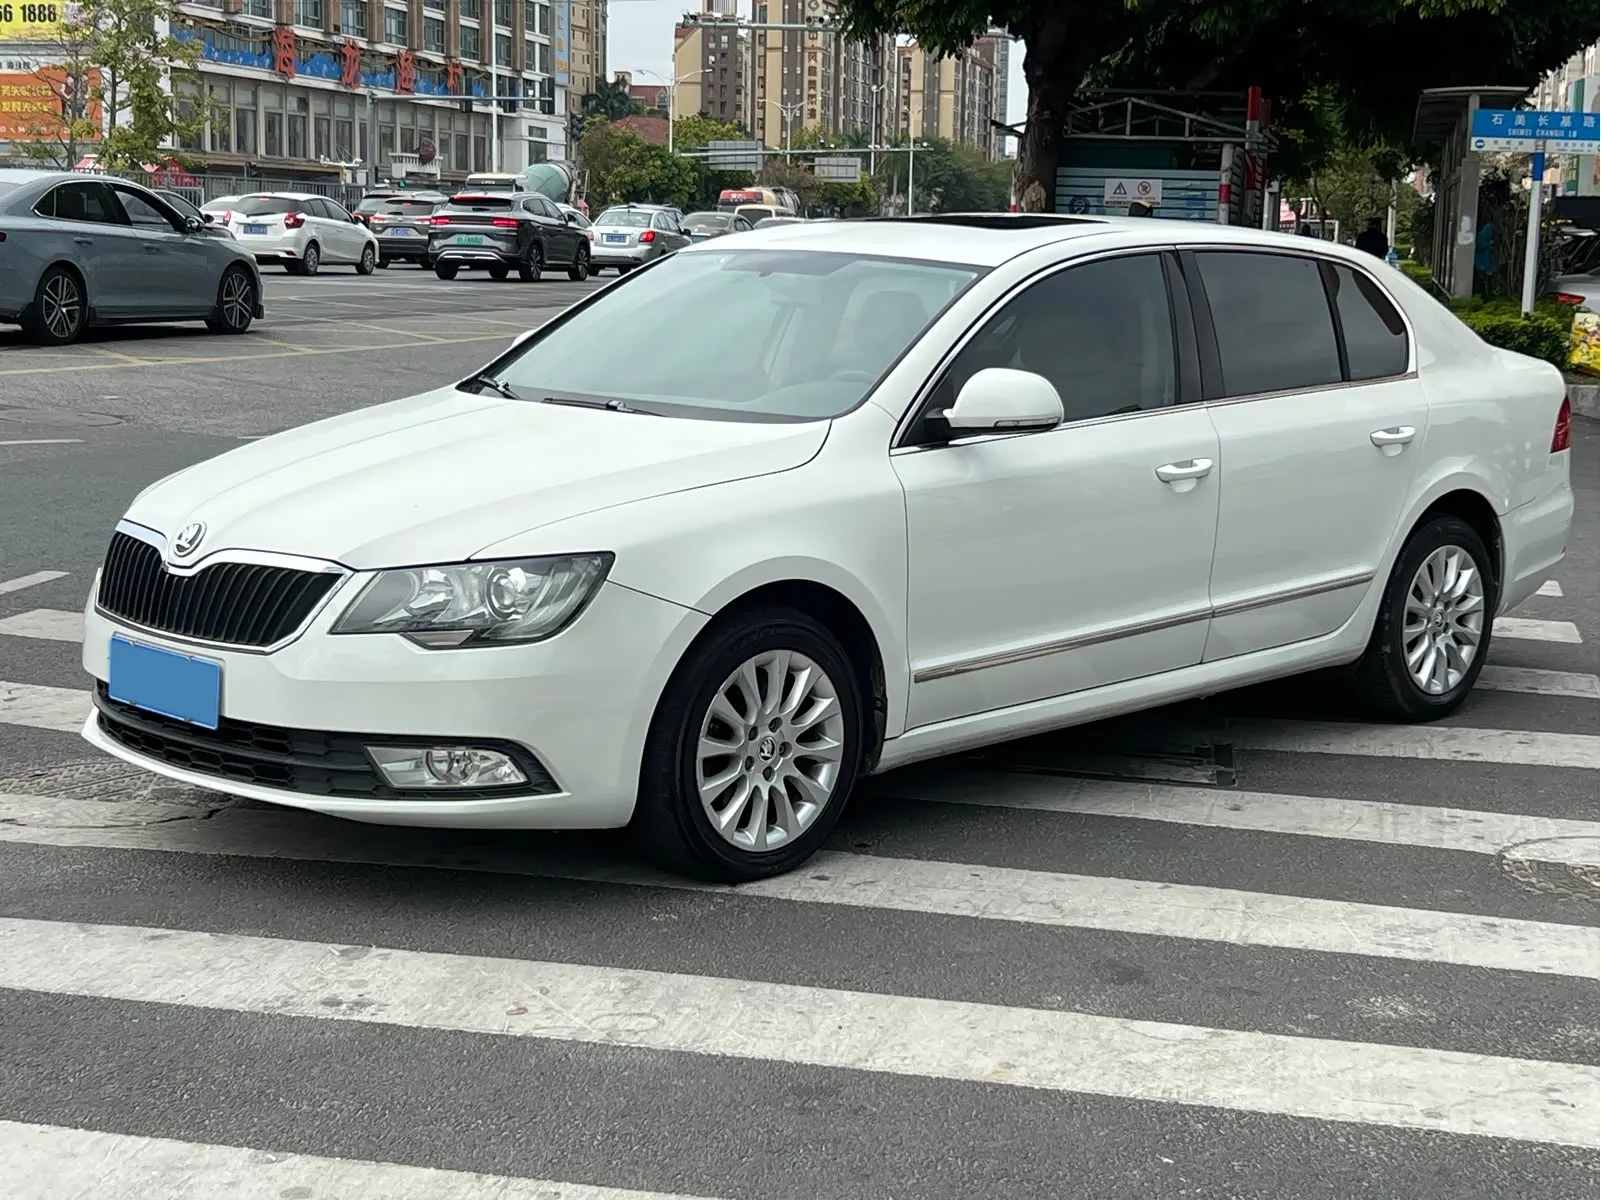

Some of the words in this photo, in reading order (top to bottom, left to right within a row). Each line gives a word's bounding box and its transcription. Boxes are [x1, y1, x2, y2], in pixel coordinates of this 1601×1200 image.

[0, 3, 13, 23] 6
[19, 3, 57, 23] 1888
[1491, 113, 1596, 128] 石美长基路
[1507, 128, 1532, 137] SHIMEI
[1568, 130, 1577, 138] LU
